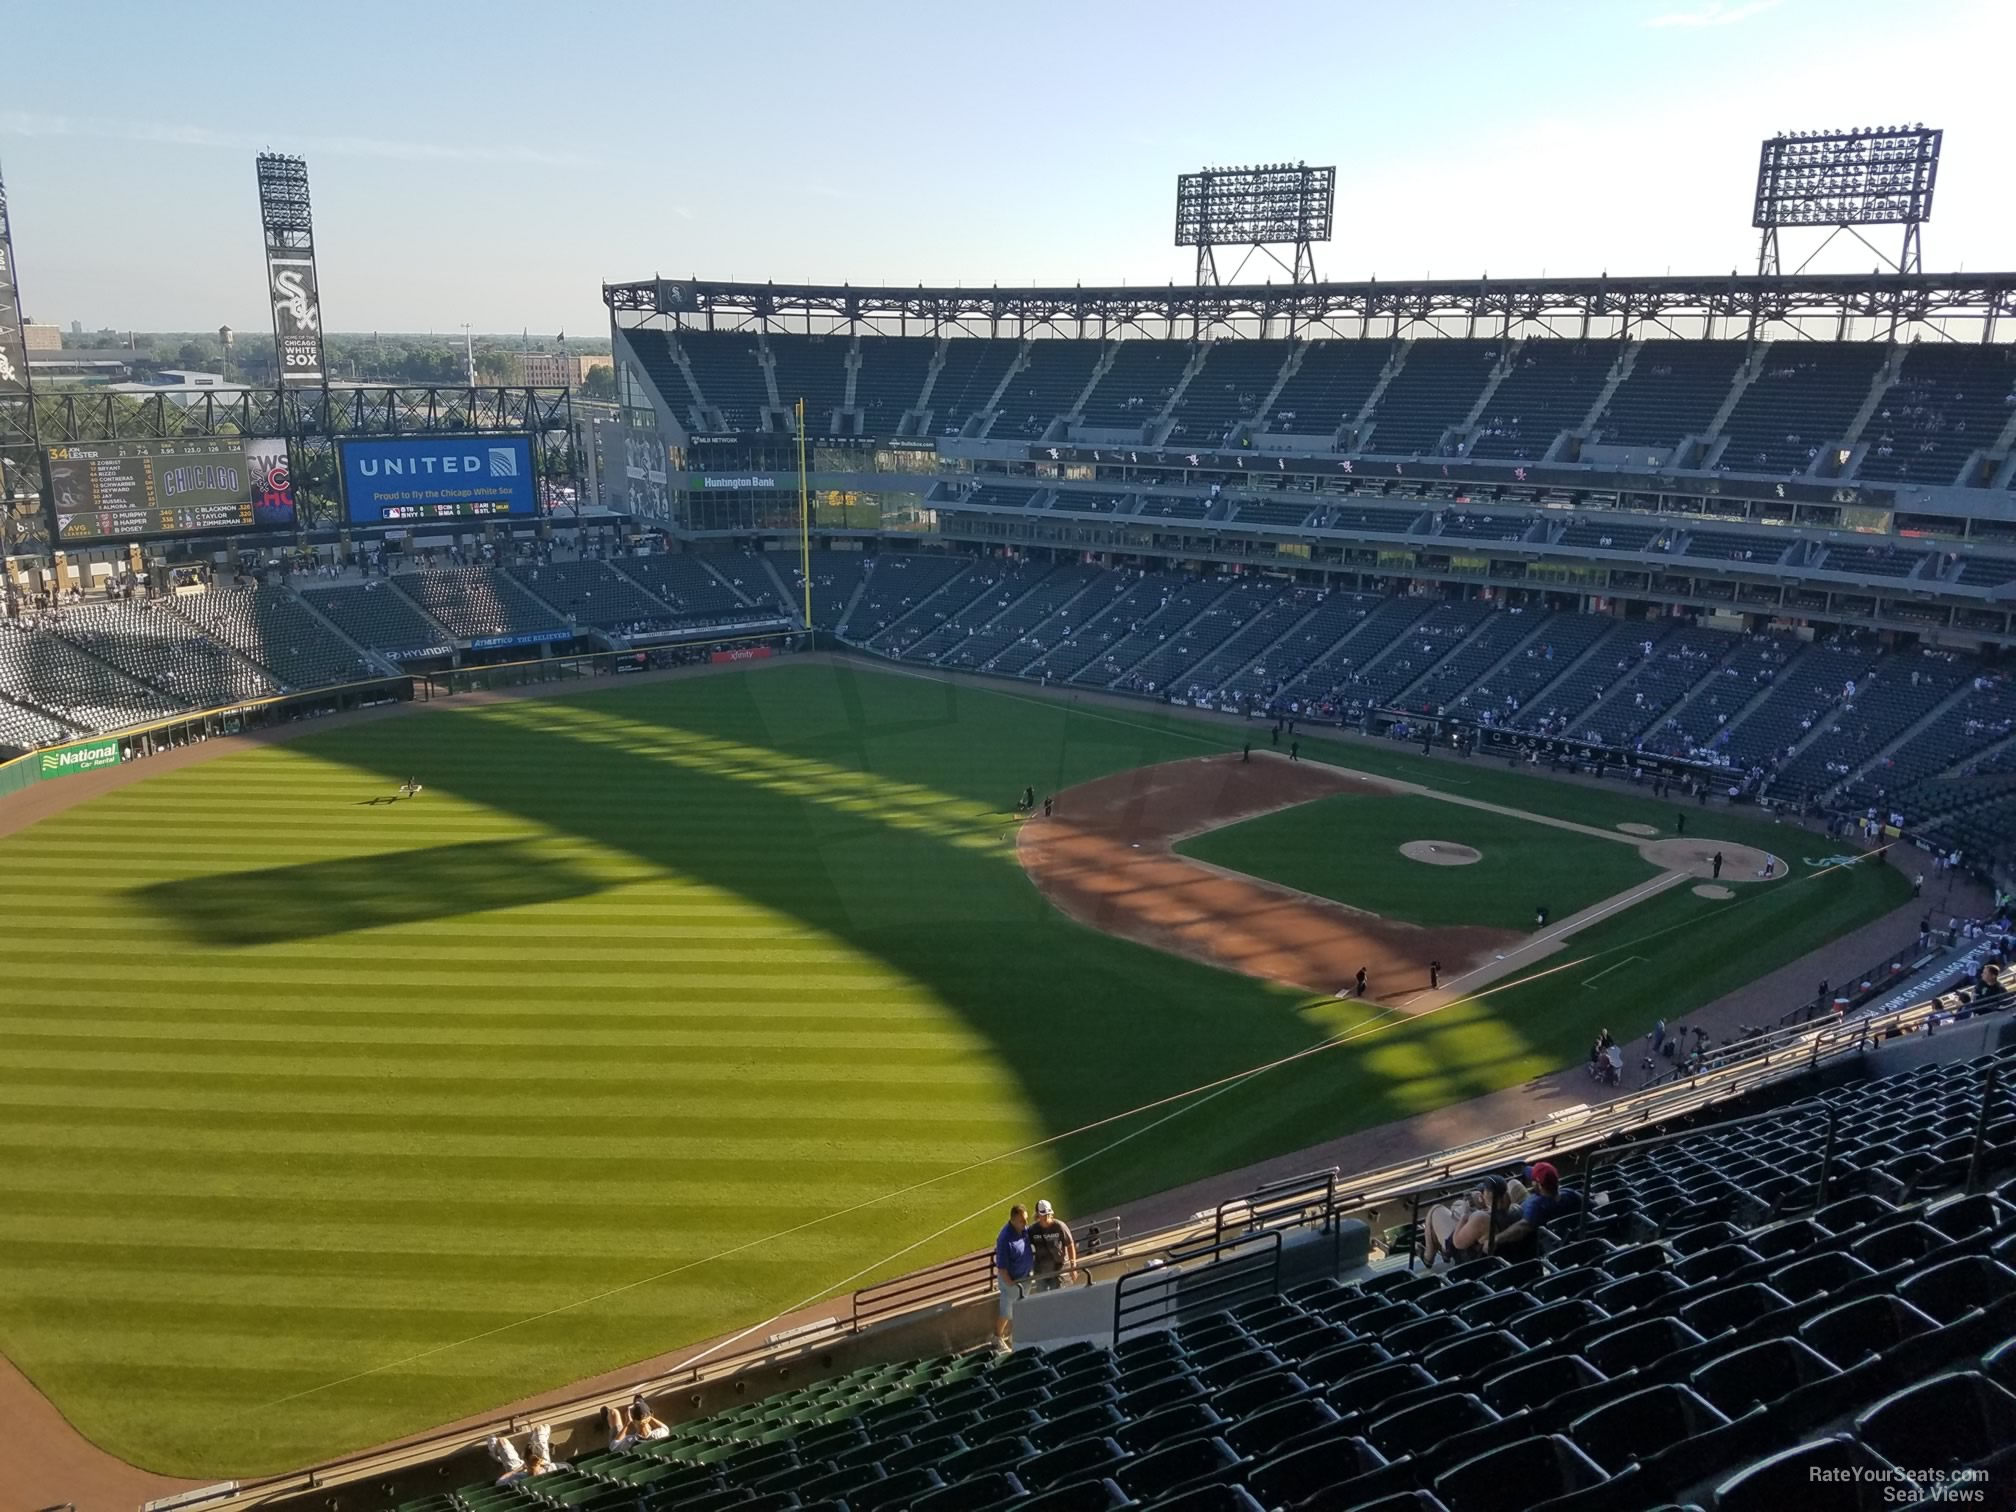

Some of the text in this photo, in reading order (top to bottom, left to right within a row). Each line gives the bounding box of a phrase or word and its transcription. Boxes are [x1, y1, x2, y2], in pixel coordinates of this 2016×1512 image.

[286, 355, 317, 366] SOX
[50, 448, 68, 459] 34
[360, 456, 480, 476] UNITED
[164, 465, 239, 496] CHICAGO
[704, 477, 774, 489] Huntington Bank
[374, 492, 400, 501] Proud
[412, 490, 423, 499] fly
[440, 489, 472, 498] Chicago
[474, 488, 497, 496] White
[474, 637, 513, 647] ATHLETICO
[533, 632, 571, 641] RELIEVERS
[402, 646, 453, 658] HYUNDAI
[731, 650, 753, 660] xfinity
[60, 744, 116, 766] National
[94, 757, 115, 765] Rental
[1878, 996, 1909, 1010] HOME
[1913, 981, 1936, 991] THE
[1929, 962, 1964, 982] CHICAGO
[1957, 949, 1984, 962] WHITE
